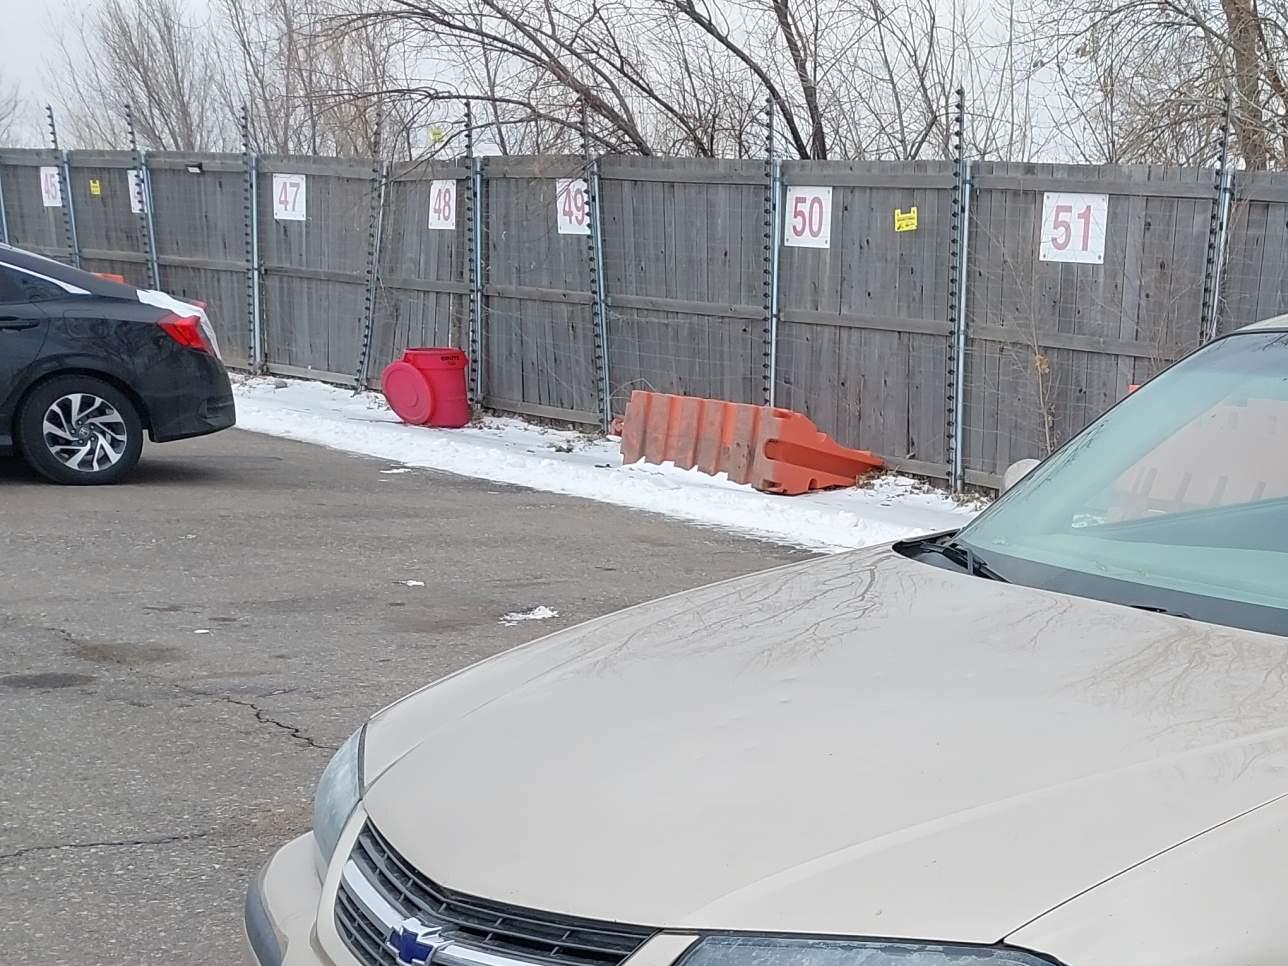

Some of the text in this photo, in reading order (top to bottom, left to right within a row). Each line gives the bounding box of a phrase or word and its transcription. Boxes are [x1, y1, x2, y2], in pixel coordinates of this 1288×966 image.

[278, 181, 301, 212] 47
[432, 187, 451, 222] 48
[562, 187, 585, 226] 49
[791, 196, 824, 239] 50
[1051, 204, 1092, 252] 51
